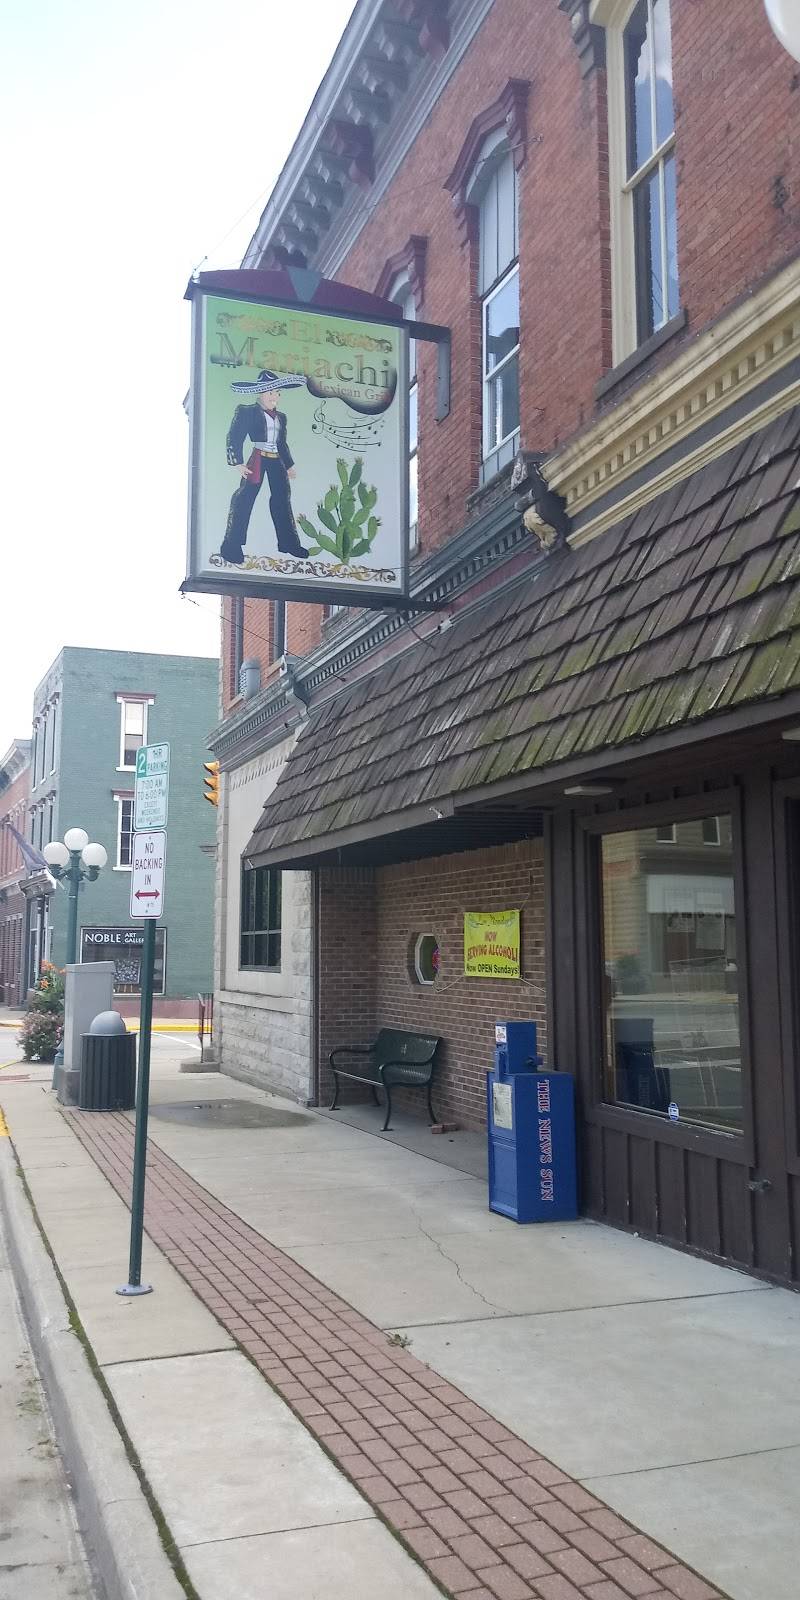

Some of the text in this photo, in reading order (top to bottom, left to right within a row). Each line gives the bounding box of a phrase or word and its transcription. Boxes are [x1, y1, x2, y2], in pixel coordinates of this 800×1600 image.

[290, 319, 323, 345] El
[214, 331, 393, 389] Mariachi
[318, 380, 361, 398] exican
[137, 753, 146, 774] 2
[147, 760, 168, 772] PARKING
[154, 778, 163, 788] AM
[145, 842, 154, 854] NO
[135, 857, 163, 871] BACKING
[144, 873, 152, 886] IN
[84, 933, 121, 943] NOBLE
[484, 931, 498, 942] NOW
[467, 944, 488, 961] SERVING
[477, 963, 493, 973] OPEN
[537, 1079, 554, 1201] THE NEWS SUN
